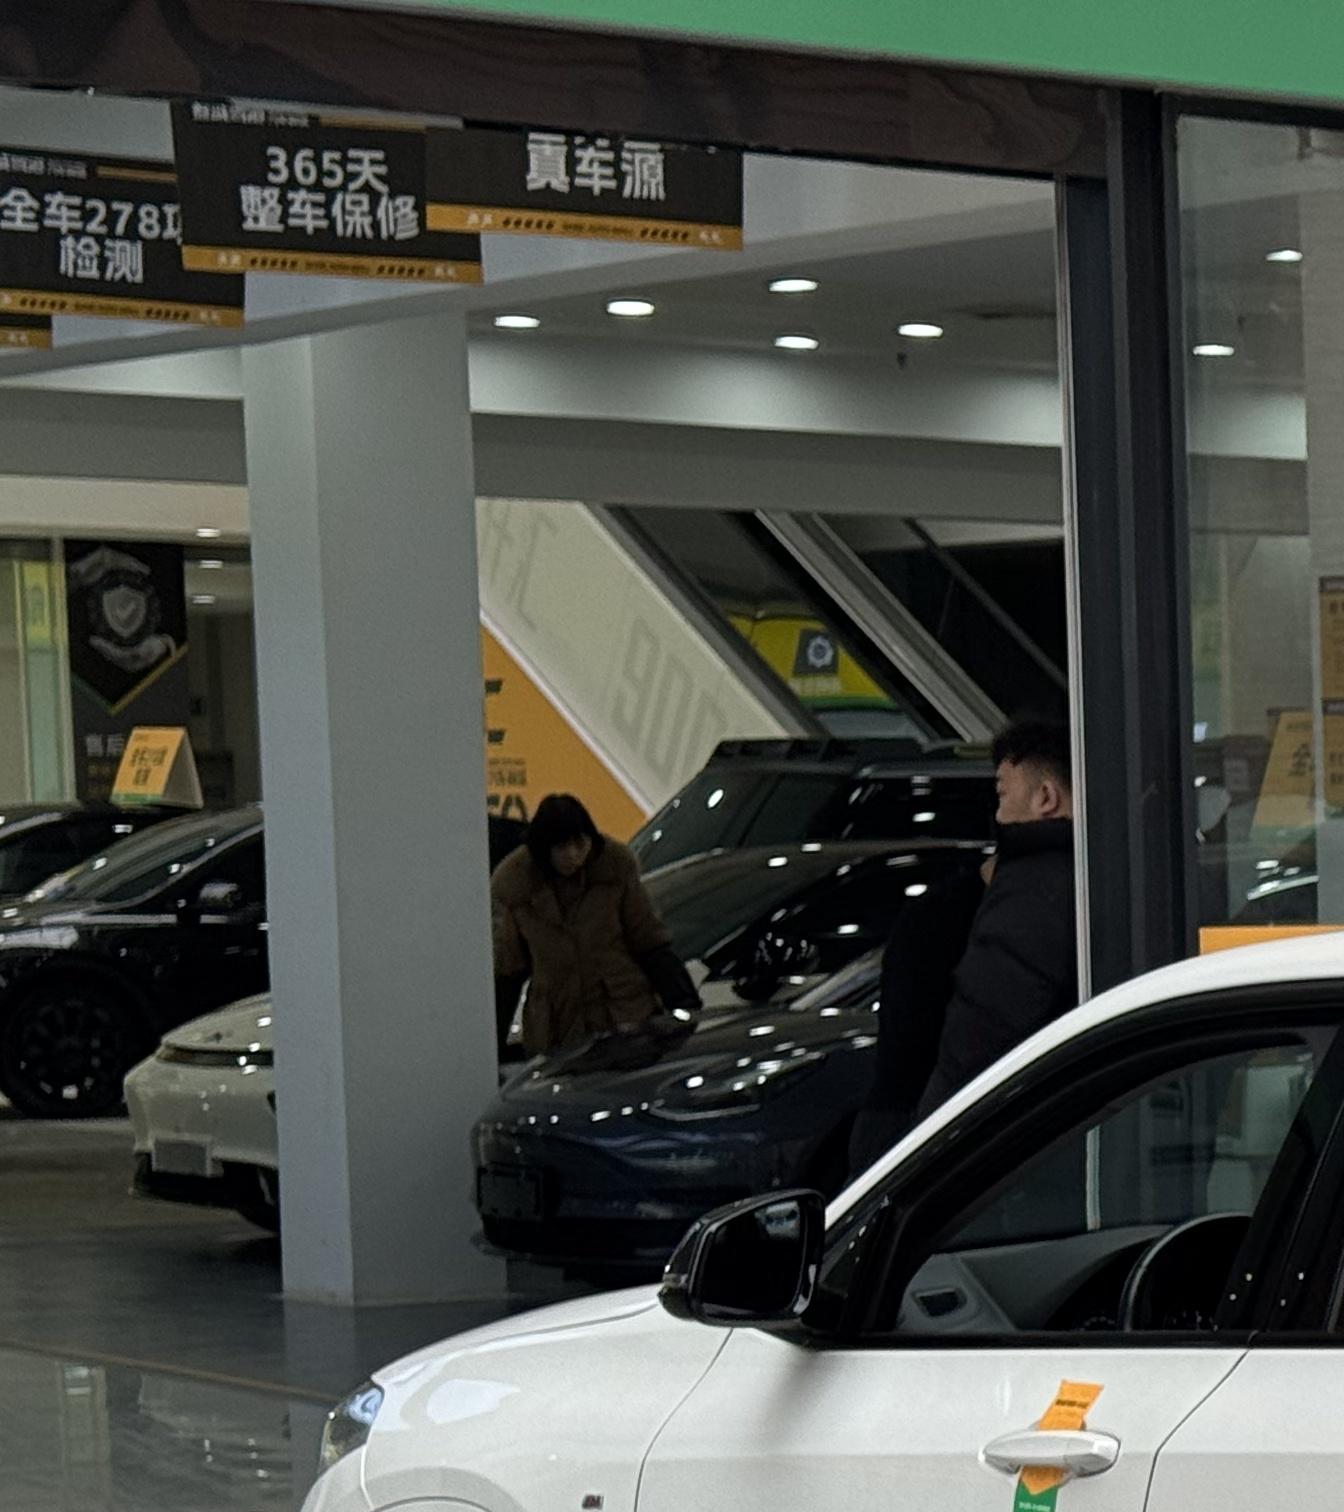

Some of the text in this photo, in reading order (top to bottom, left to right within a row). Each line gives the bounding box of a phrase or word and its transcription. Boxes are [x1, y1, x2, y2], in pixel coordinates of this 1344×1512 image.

[266, 146, 390, 194] 365天
[526, 143, 666, 201] 真车源
[240, 185, 419, 241] 整车保修
[59, 233, 144, 283] 检测
